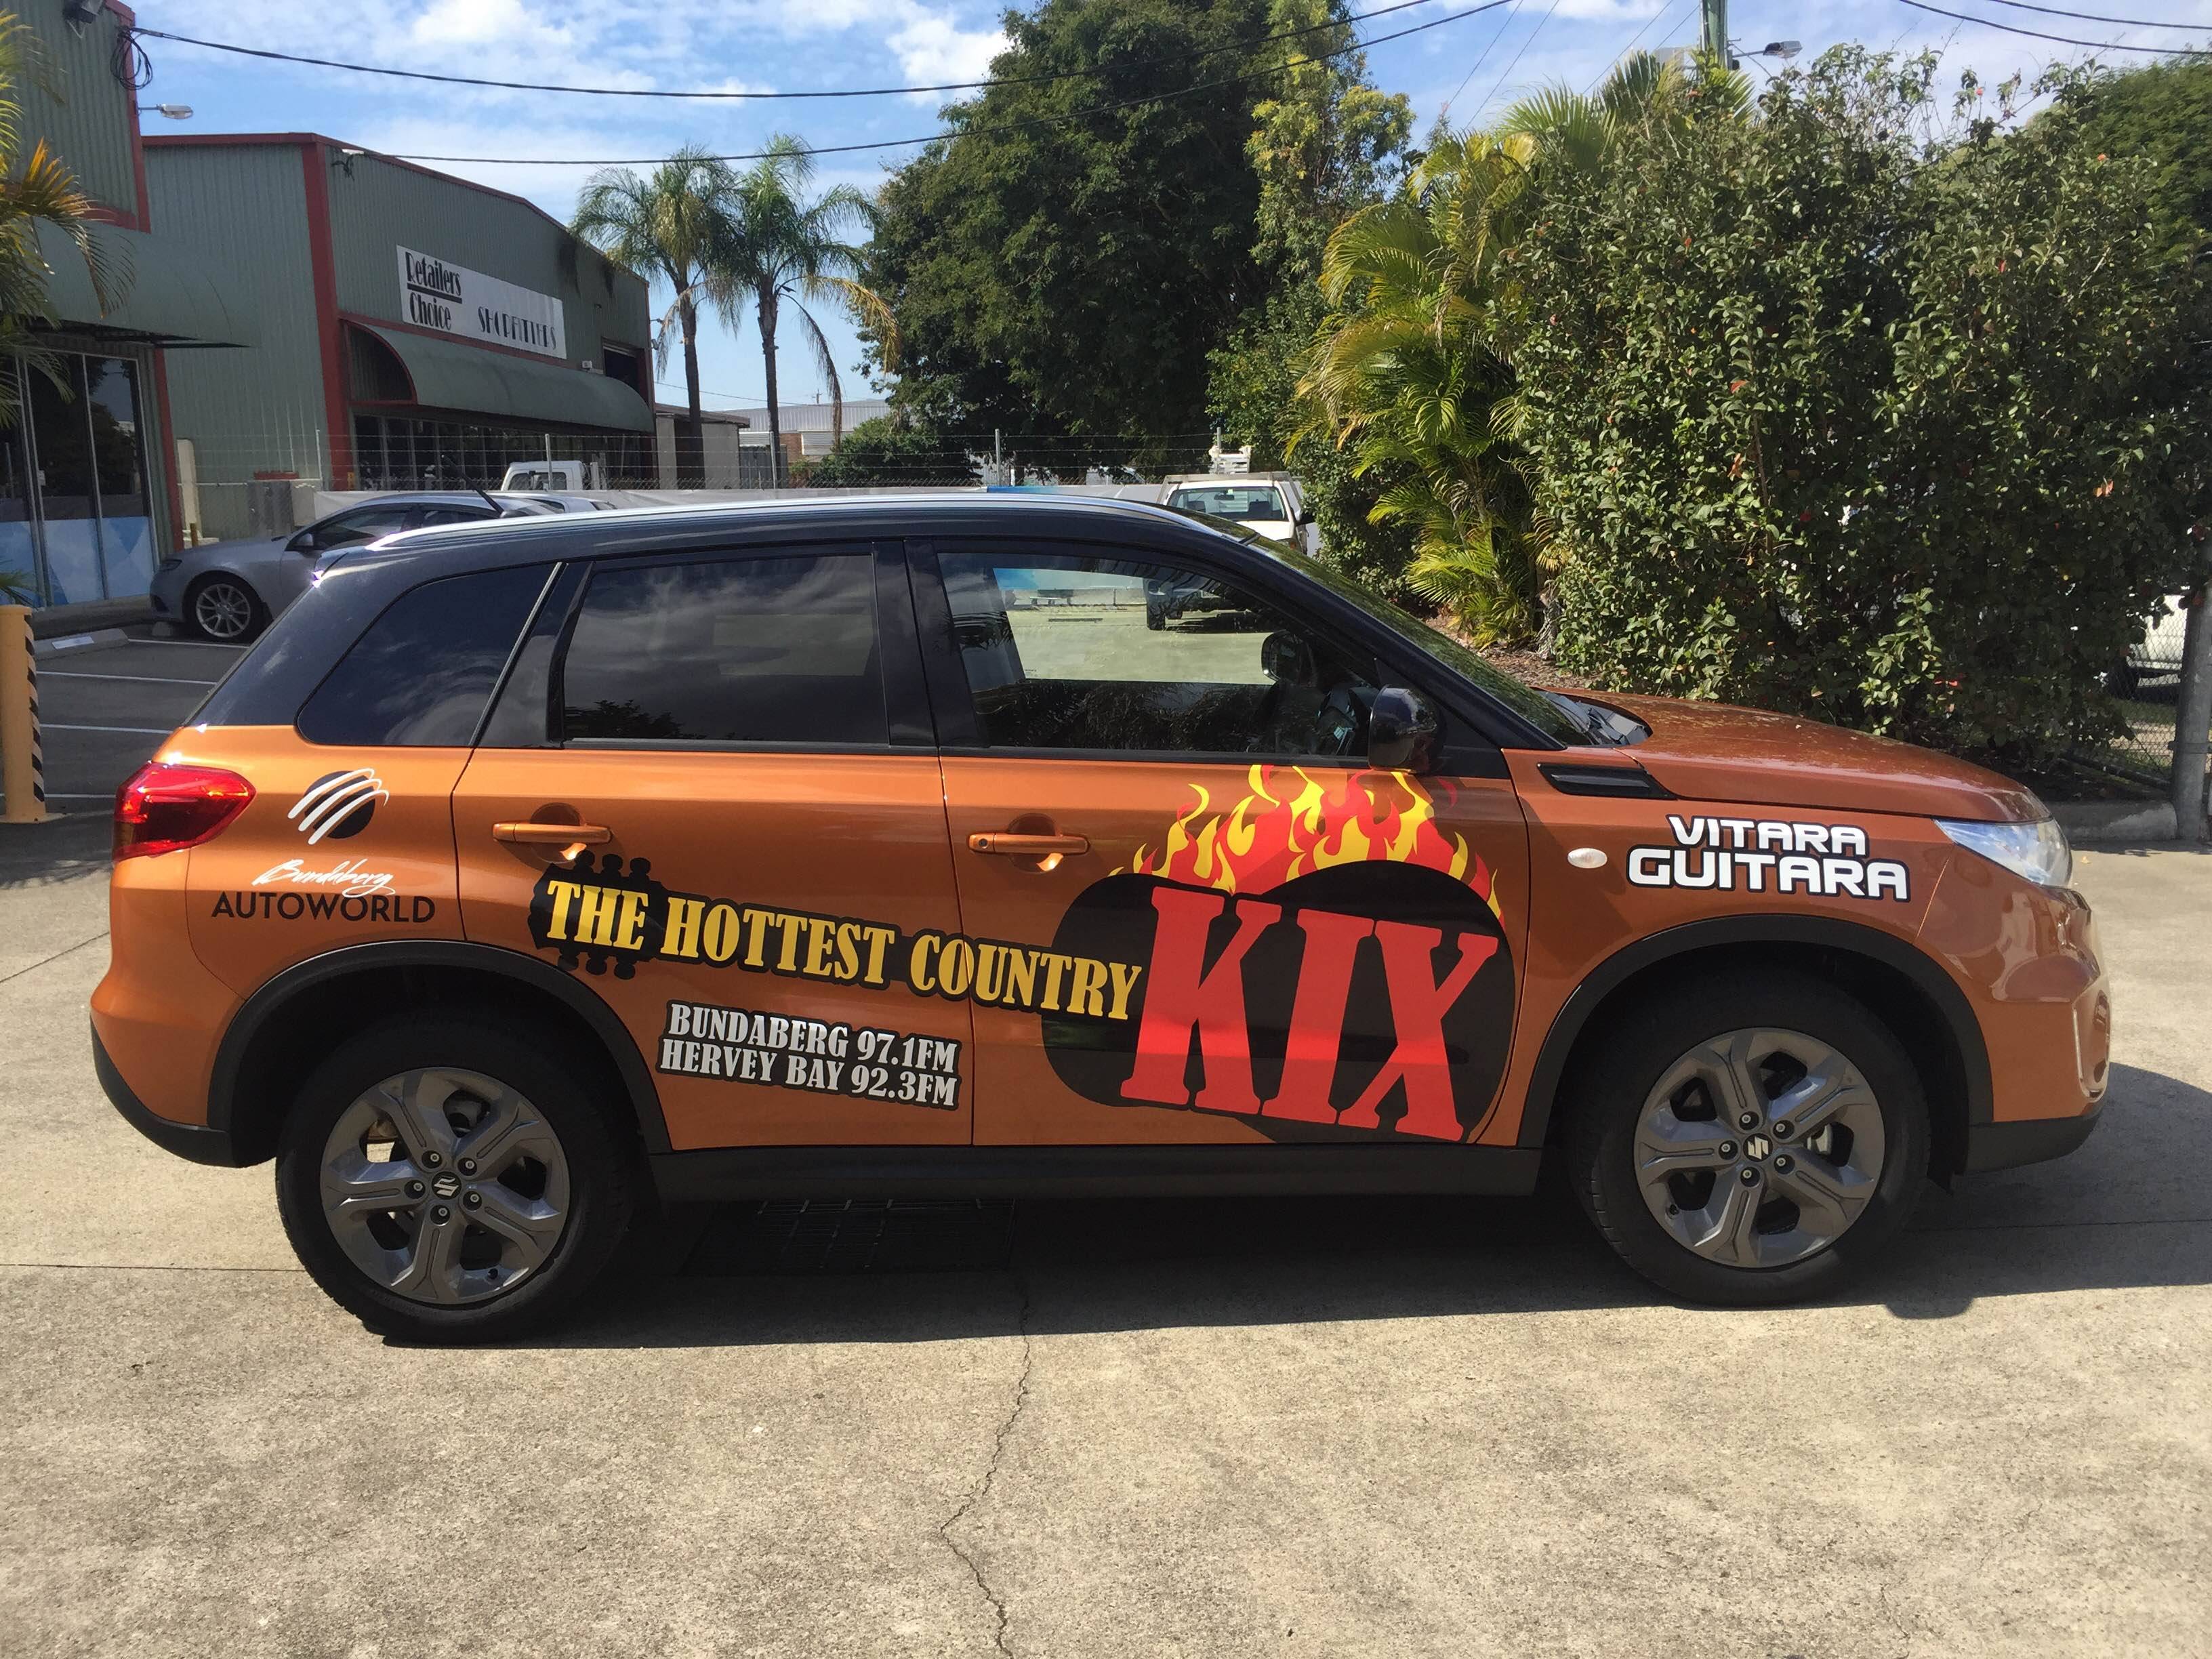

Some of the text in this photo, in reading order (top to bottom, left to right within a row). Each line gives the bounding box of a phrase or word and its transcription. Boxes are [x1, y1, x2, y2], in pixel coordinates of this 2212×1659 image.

[405, 251, 462, 296] Retailers
[409, 292, 451, 331] Choice
[1668, 816, 1866, 856] VITARA
[251, 859, 396, 898] Bundaberg
[1629, 848, 1908, 899] GUITARA
[211, 890, 435, 923] AUTOWORLD
[546, 880, 1498, 1141] THE HOTTEST COUNTRY KIX
[668, 1003, 958, 1073] BUNDABERG 97.1FM
[660, 1039, 958, 1107] HERVEY BAY 92.3FM
